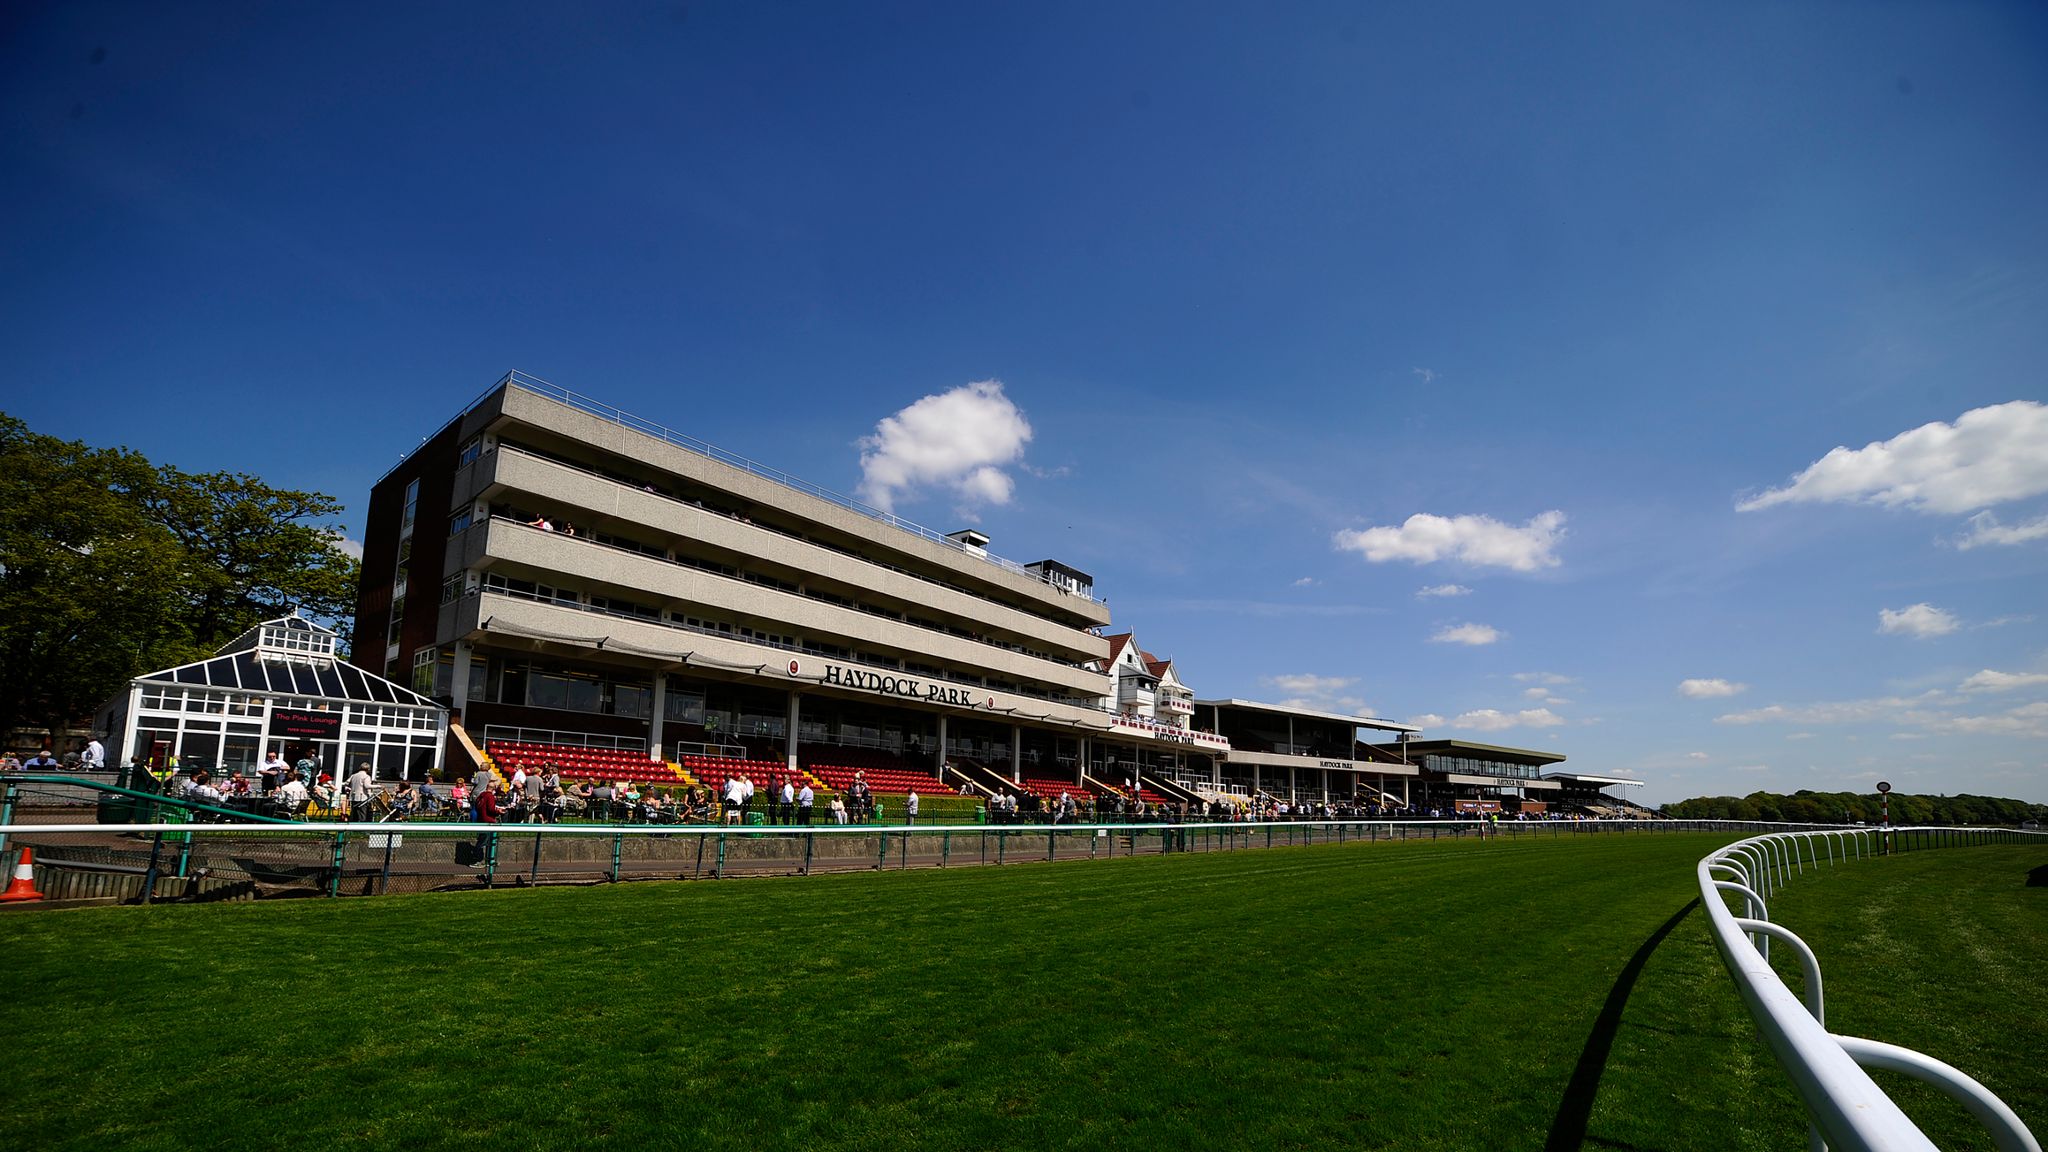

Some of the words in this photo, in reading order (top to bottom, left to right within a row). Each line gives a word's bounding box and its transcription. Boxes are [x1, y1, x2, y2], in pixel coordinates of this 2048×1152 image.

[824, 664, 920, 697] HAYDOCK
[928, 684, 972, 707] PARK
[275, 713, 290, 721] The
[292, 714, 308, 722] Pink
[310, 716, 338, 725] Lounge
[1154, 731, 1179, 743] HAYDOCK
[1181, 736, 1195, 745] PARK
[1319, 760, 1341, 769] HAYDOCK
